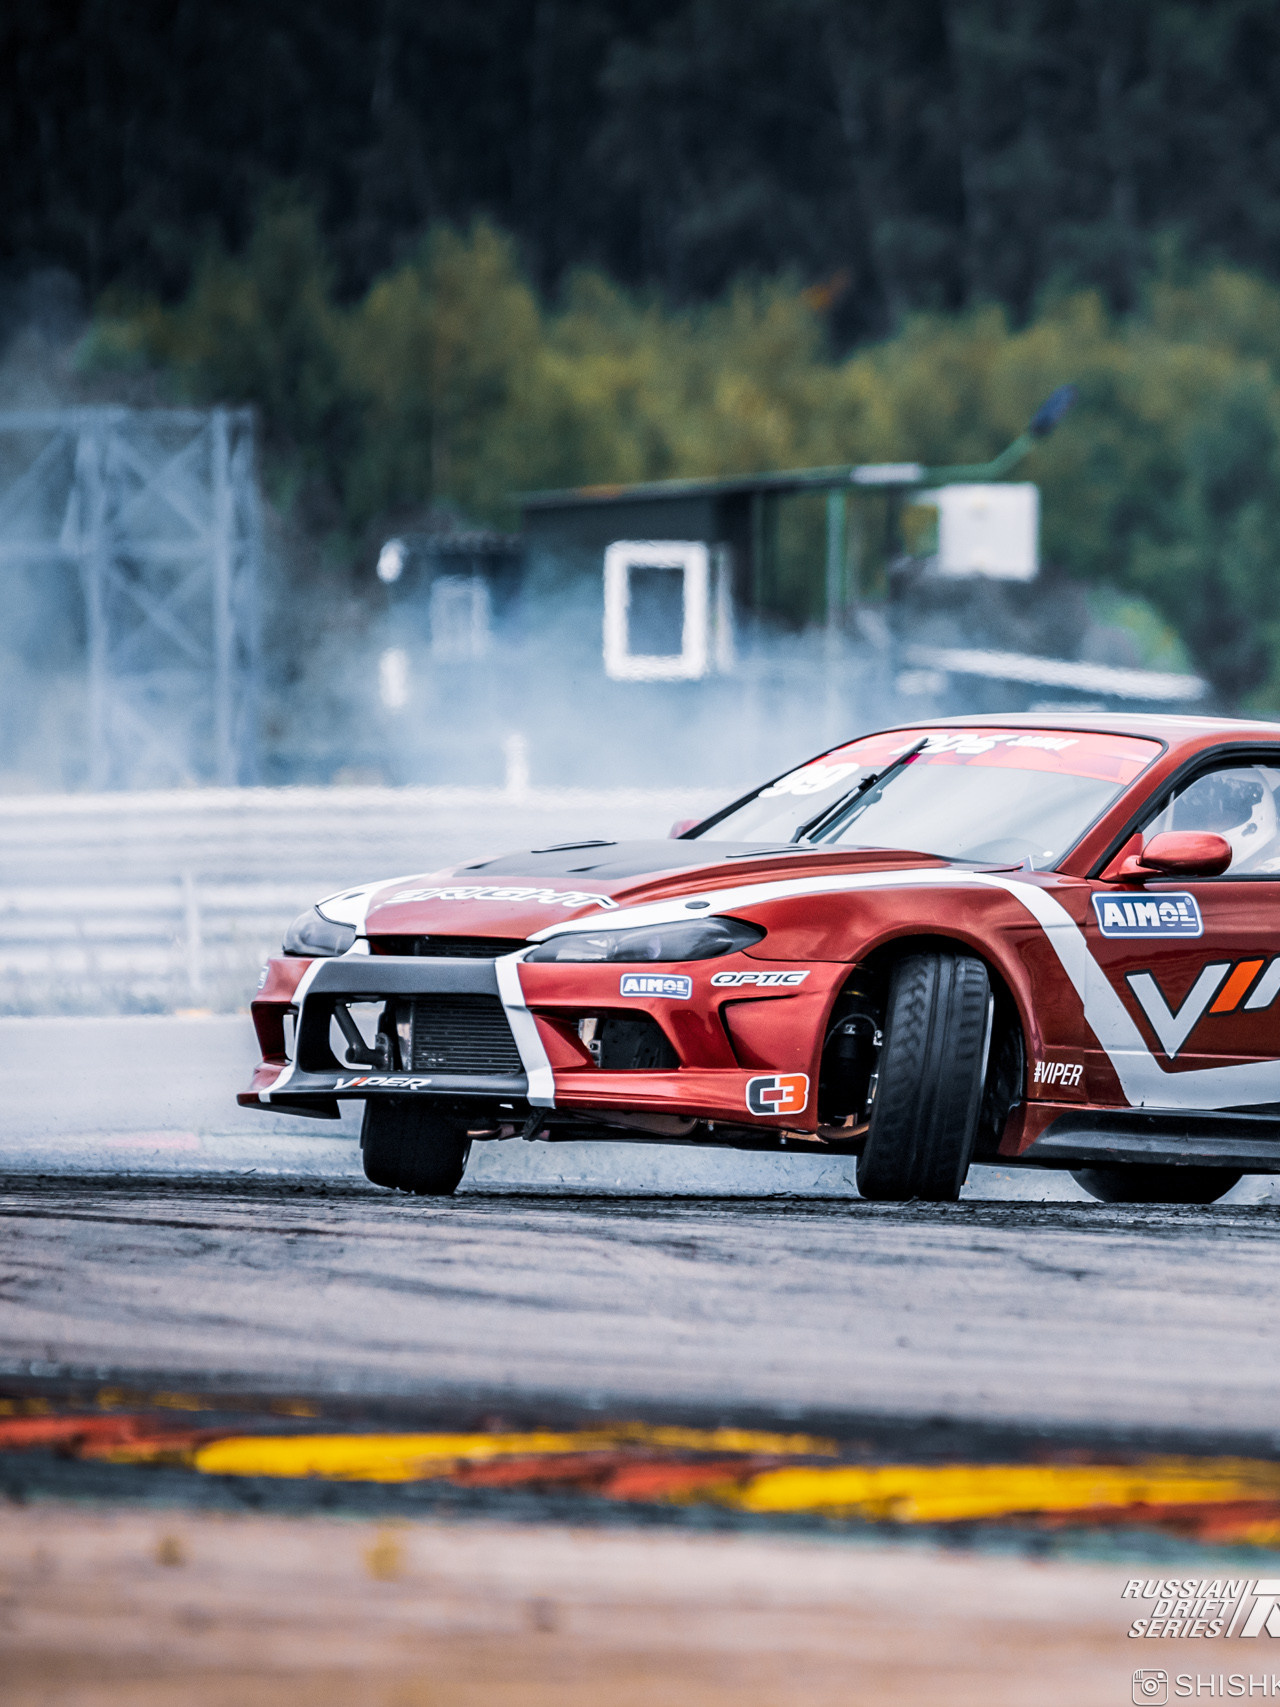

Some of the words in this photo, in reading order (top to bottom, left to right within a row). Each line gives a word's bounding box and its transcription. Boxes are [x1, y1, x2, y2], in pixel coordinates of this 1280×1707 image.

[759, 763, 860, 798] 99
[1104, 902, 1197, 927] AIMOL
[623, 978, 688, 995] AIMOL
[712, 972, 806, 985] OPTIC
[333, 1076, 432, 1090] VIPER
[1034, 1061, 1083, 1086] #VIPER
